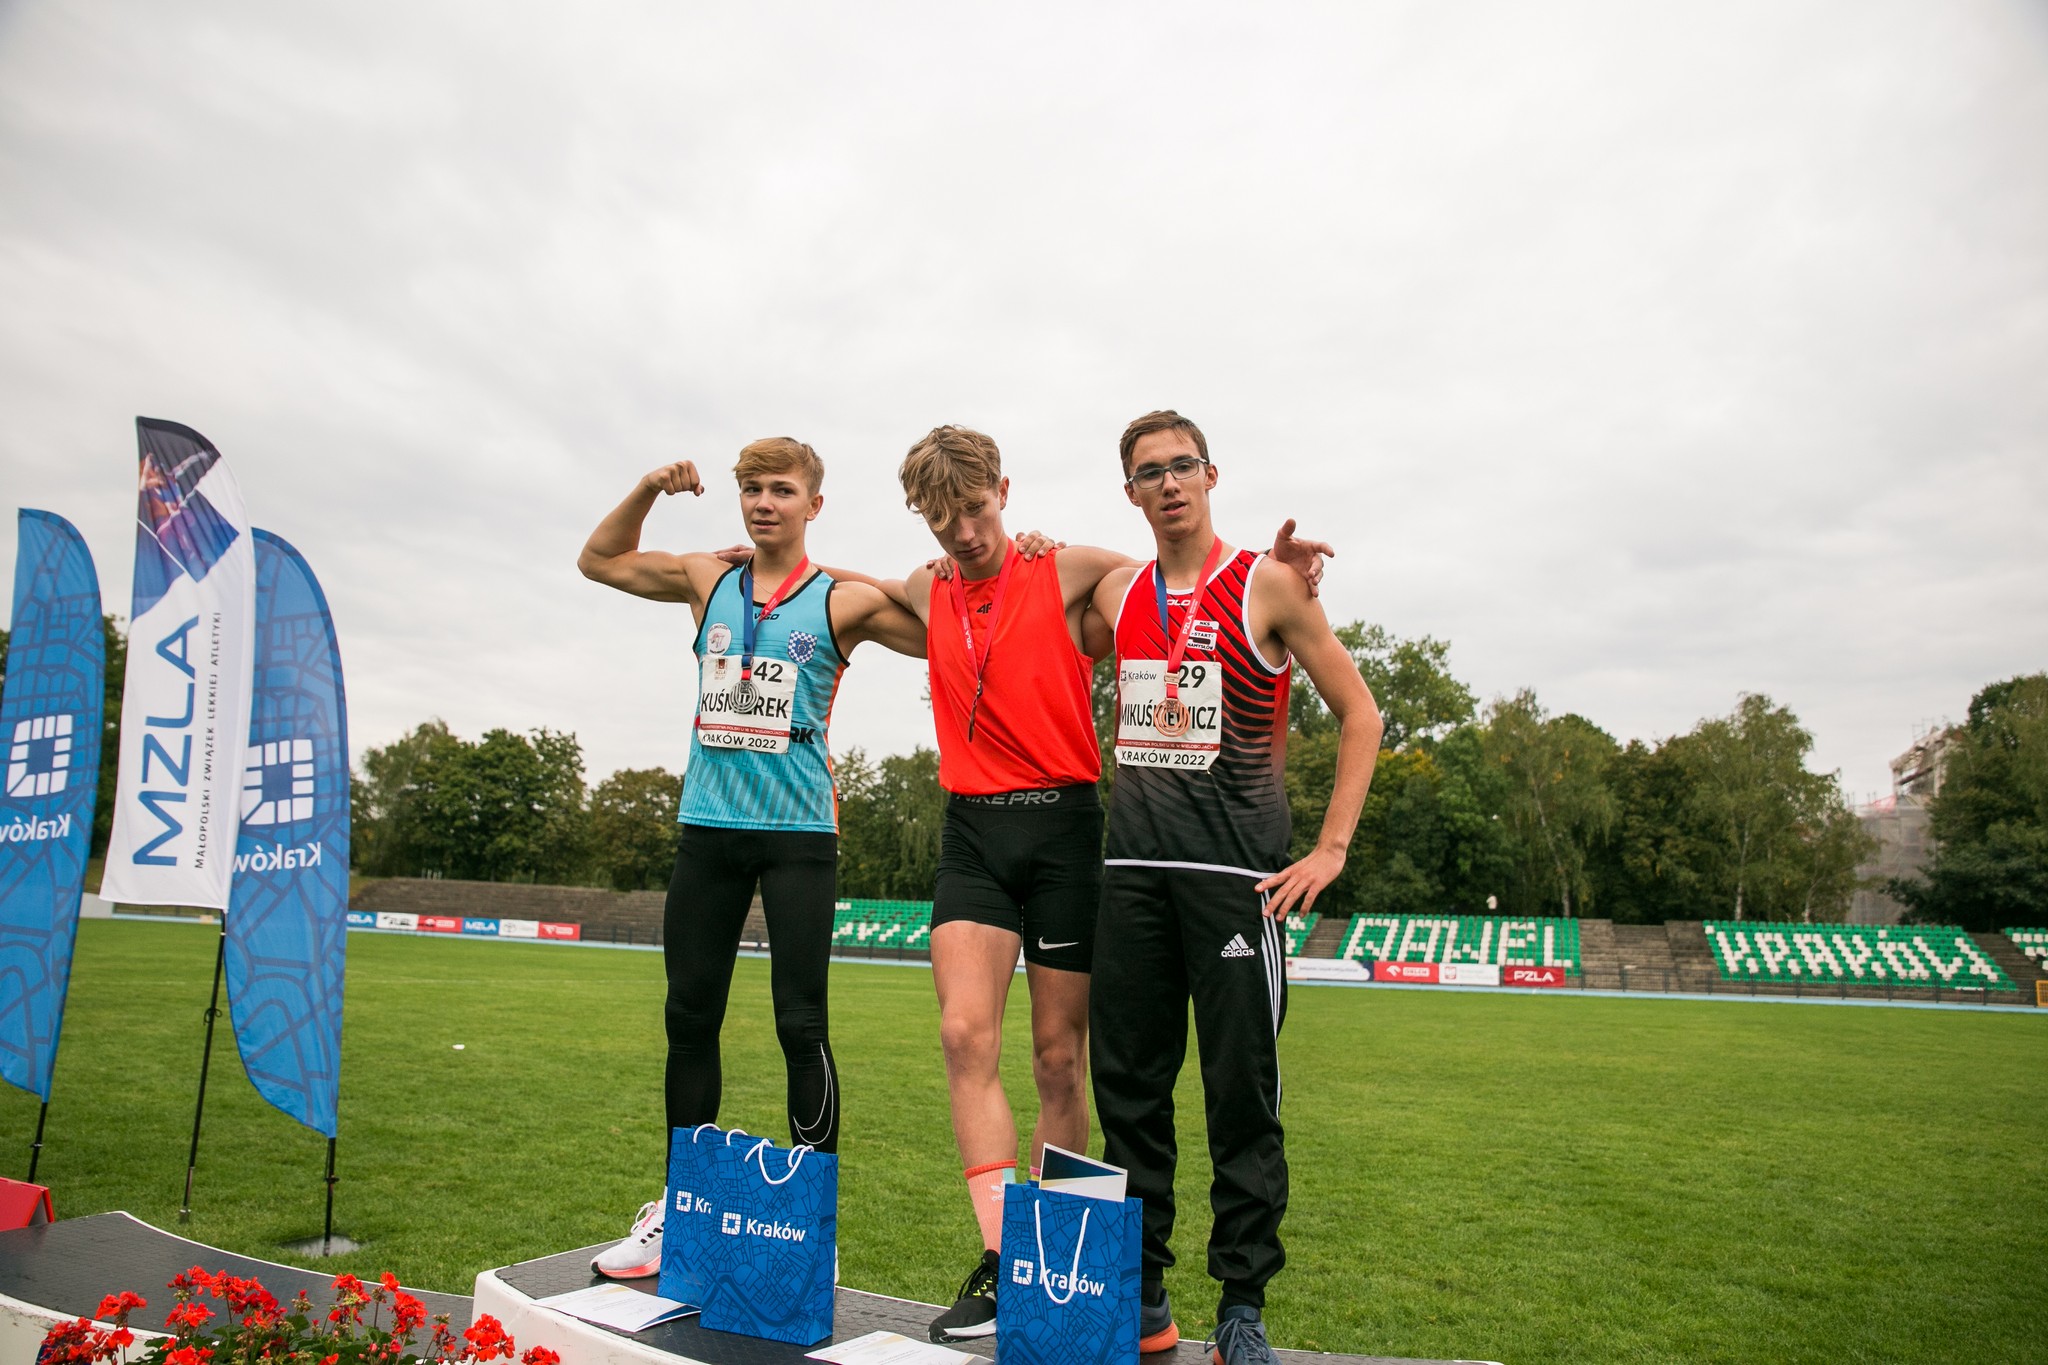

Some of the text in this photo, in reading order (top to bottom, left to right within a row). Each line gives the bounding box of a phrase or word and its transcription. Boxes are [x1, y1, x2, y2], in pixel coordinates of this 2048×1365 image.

[1182, 614, 1194, 635] PZLA
[753, 661, 783, 683] 42
[1128, 670, 1157, 680] Kraków
[1178, 665, 1206, 688] 29
[132, 614, 199, 867] MZLA
[194, 612, 221, 868] MAŁOPOLSKI ZWIĄZEK LEKKIEJ ATLETYKI
[702, 732, 777, 749] KRAKÓW 2022
[1121, 750, 1206, 766] KRAKÓW 2022
[1008, 790, 1060, 805] PRO
[1221, 948, 1255, 957] adidas
[1513, 970, 1555, 982] PZLA
[746, 1218, 806, 1242] Kraków
[1039, 1268, 1105, 1297] Kraków
